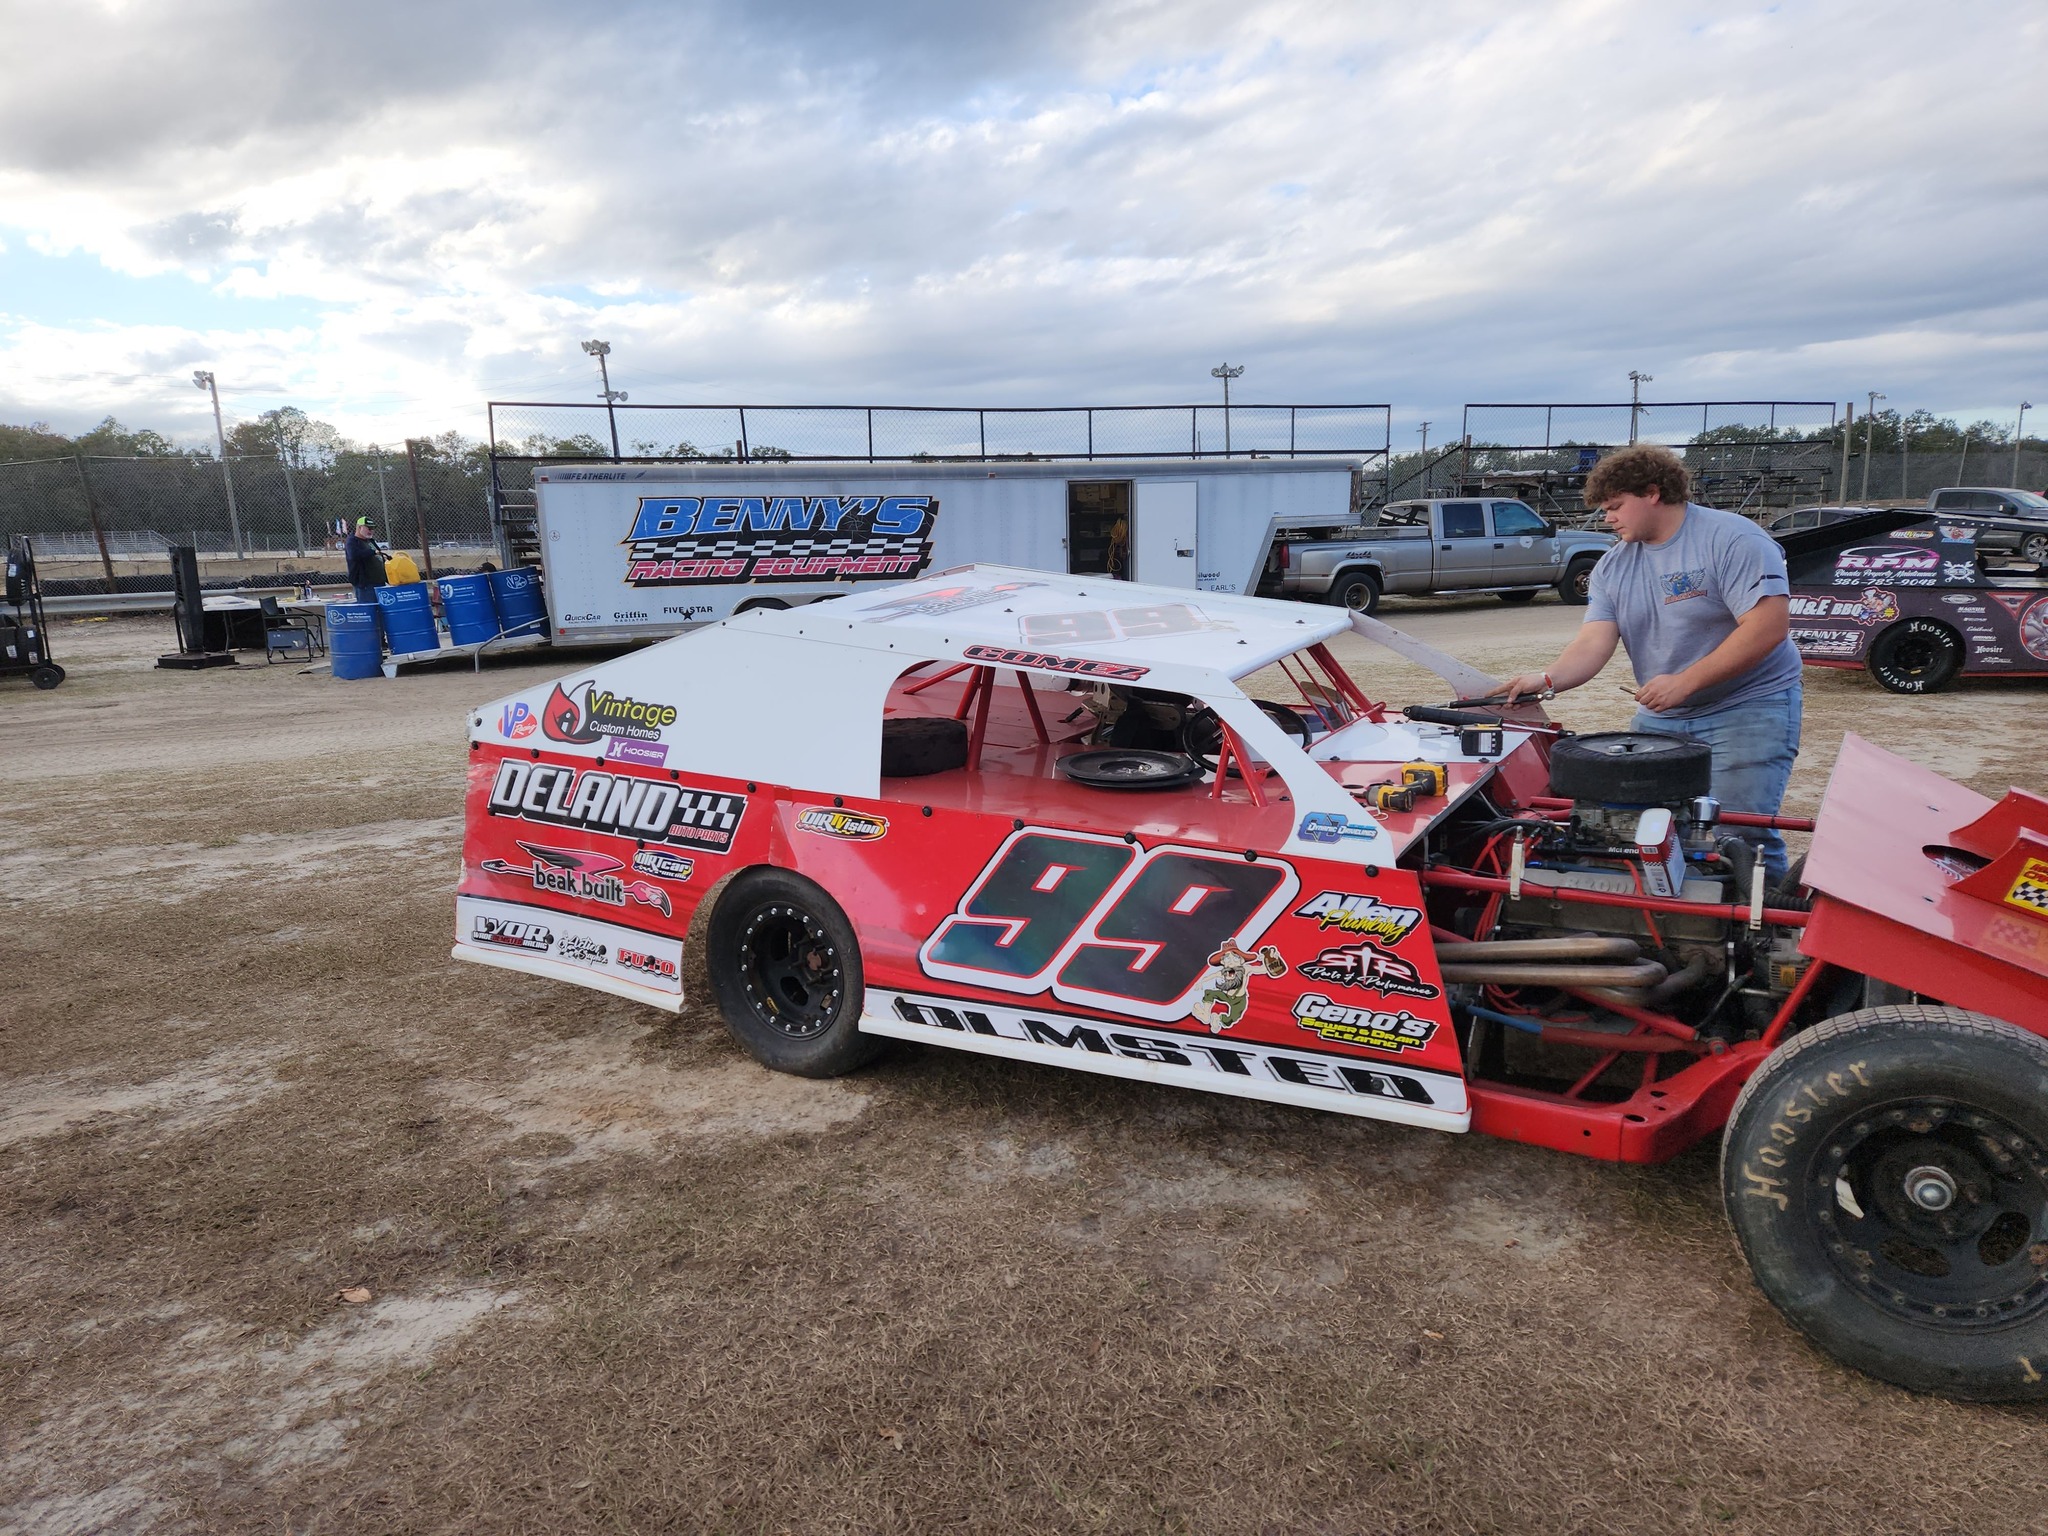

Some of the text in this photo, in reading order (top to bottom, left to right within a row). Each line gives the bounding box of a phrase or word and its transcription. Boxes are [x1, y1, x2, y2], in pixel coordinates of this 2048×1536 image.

[570, 472, 626, 480] FEATHERLITE
[627, 497, 929, 541] BENNY'S
[628, 555, 922, 581] RACING EQUIPMENT
[1832, 578, 1937, 586] 386-785-9048
[664, 606, 684, 614] FIVE
[1831, 602, 1864, 616] BBQ
[1022, 604, 1204, 646] 99
[1908, 621, 1954, 648] Hoosier
[965, 646, 1149, 680] GOMEZ
[1974, 645, 2004, 654] Hoosier
[1880, 665, 1926, 692] Hoosier
[503, 702, 529, 738] VP
[590, 691, 676, 726] Vintage
[589, 719, 660, 739] Custom Homes
[624, 747, 665, 760] HOOSIER
[491, 762, 681, 833] DELAND
[668, 824, 729, 842] AUTO PARTS
[636, 852, 690, 872] DIRTcar
[926, 833, 1288, 1006] 99
[1297, 892, 1419, 928] Allen
[1320, 909, 1407, 943] Plumbing
[1303, 965, 1342, 979] Parts
[1356, 974, 1433, 996] Performance
[1295, 993, 1431, 1038] Geno's
[892, 999, 1436, 1105] OLMSTED
[1743, 1059, 1870, 1212] Hoosier
